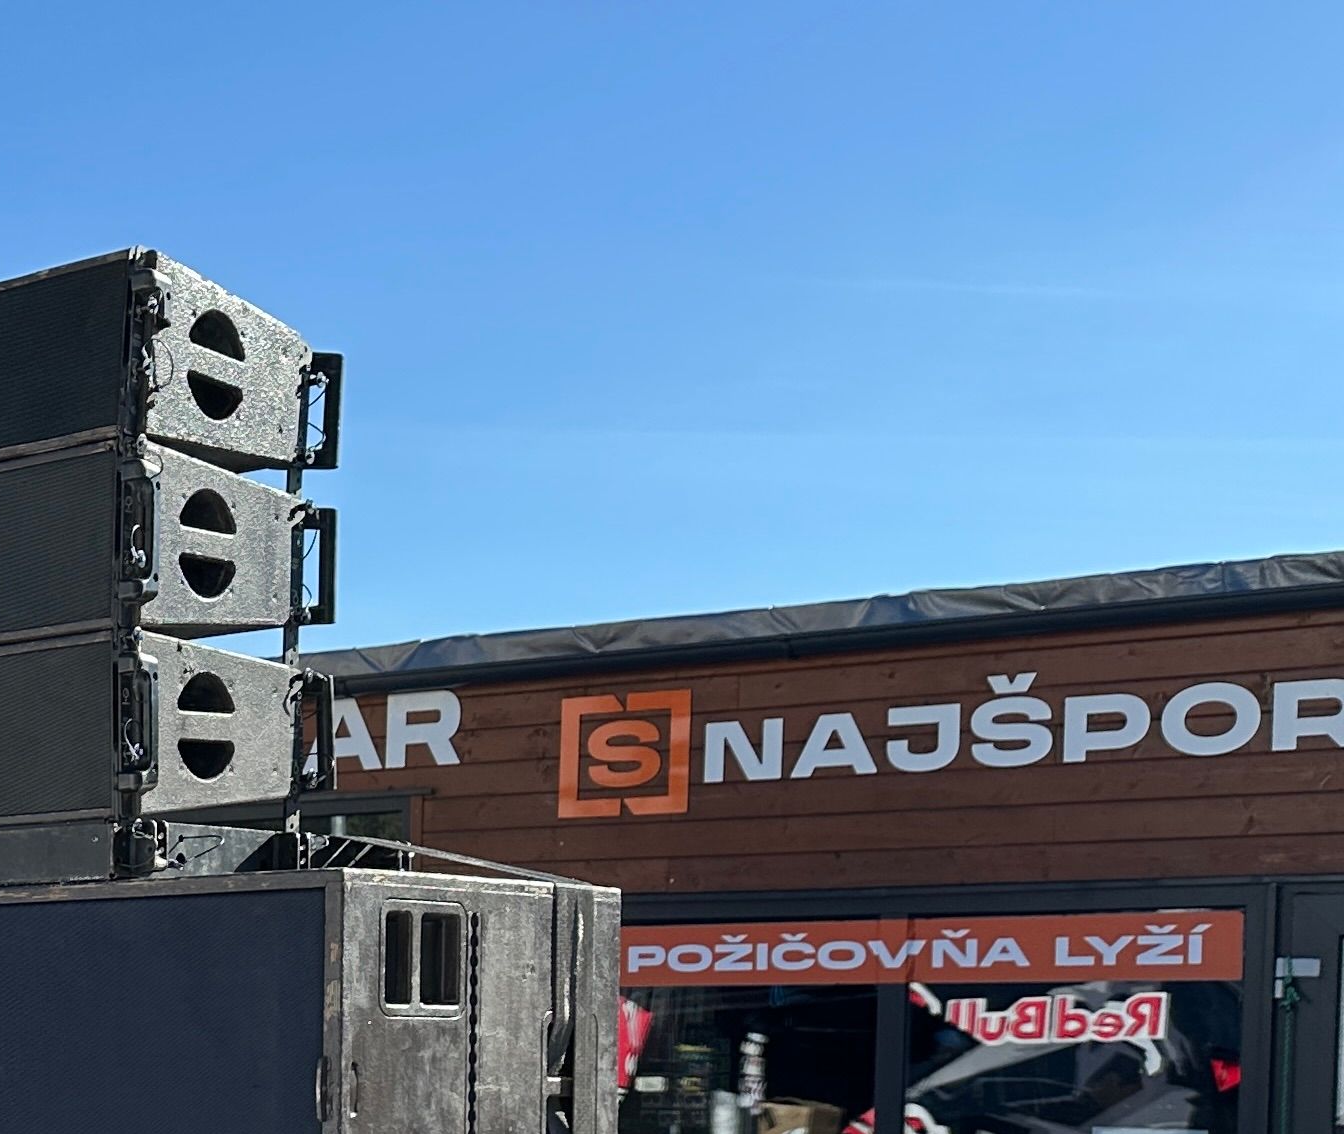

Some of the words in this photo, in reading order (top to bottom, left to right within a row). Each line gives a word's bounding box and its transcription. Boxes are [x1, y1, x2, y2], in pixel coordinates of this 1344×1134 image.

[704, 673, 1344, 784] NAJŠPOR
[627, 928, 1029, 973] POŽIČOVŇA
[1055, 922, 1214, 966] LYŽÍ
